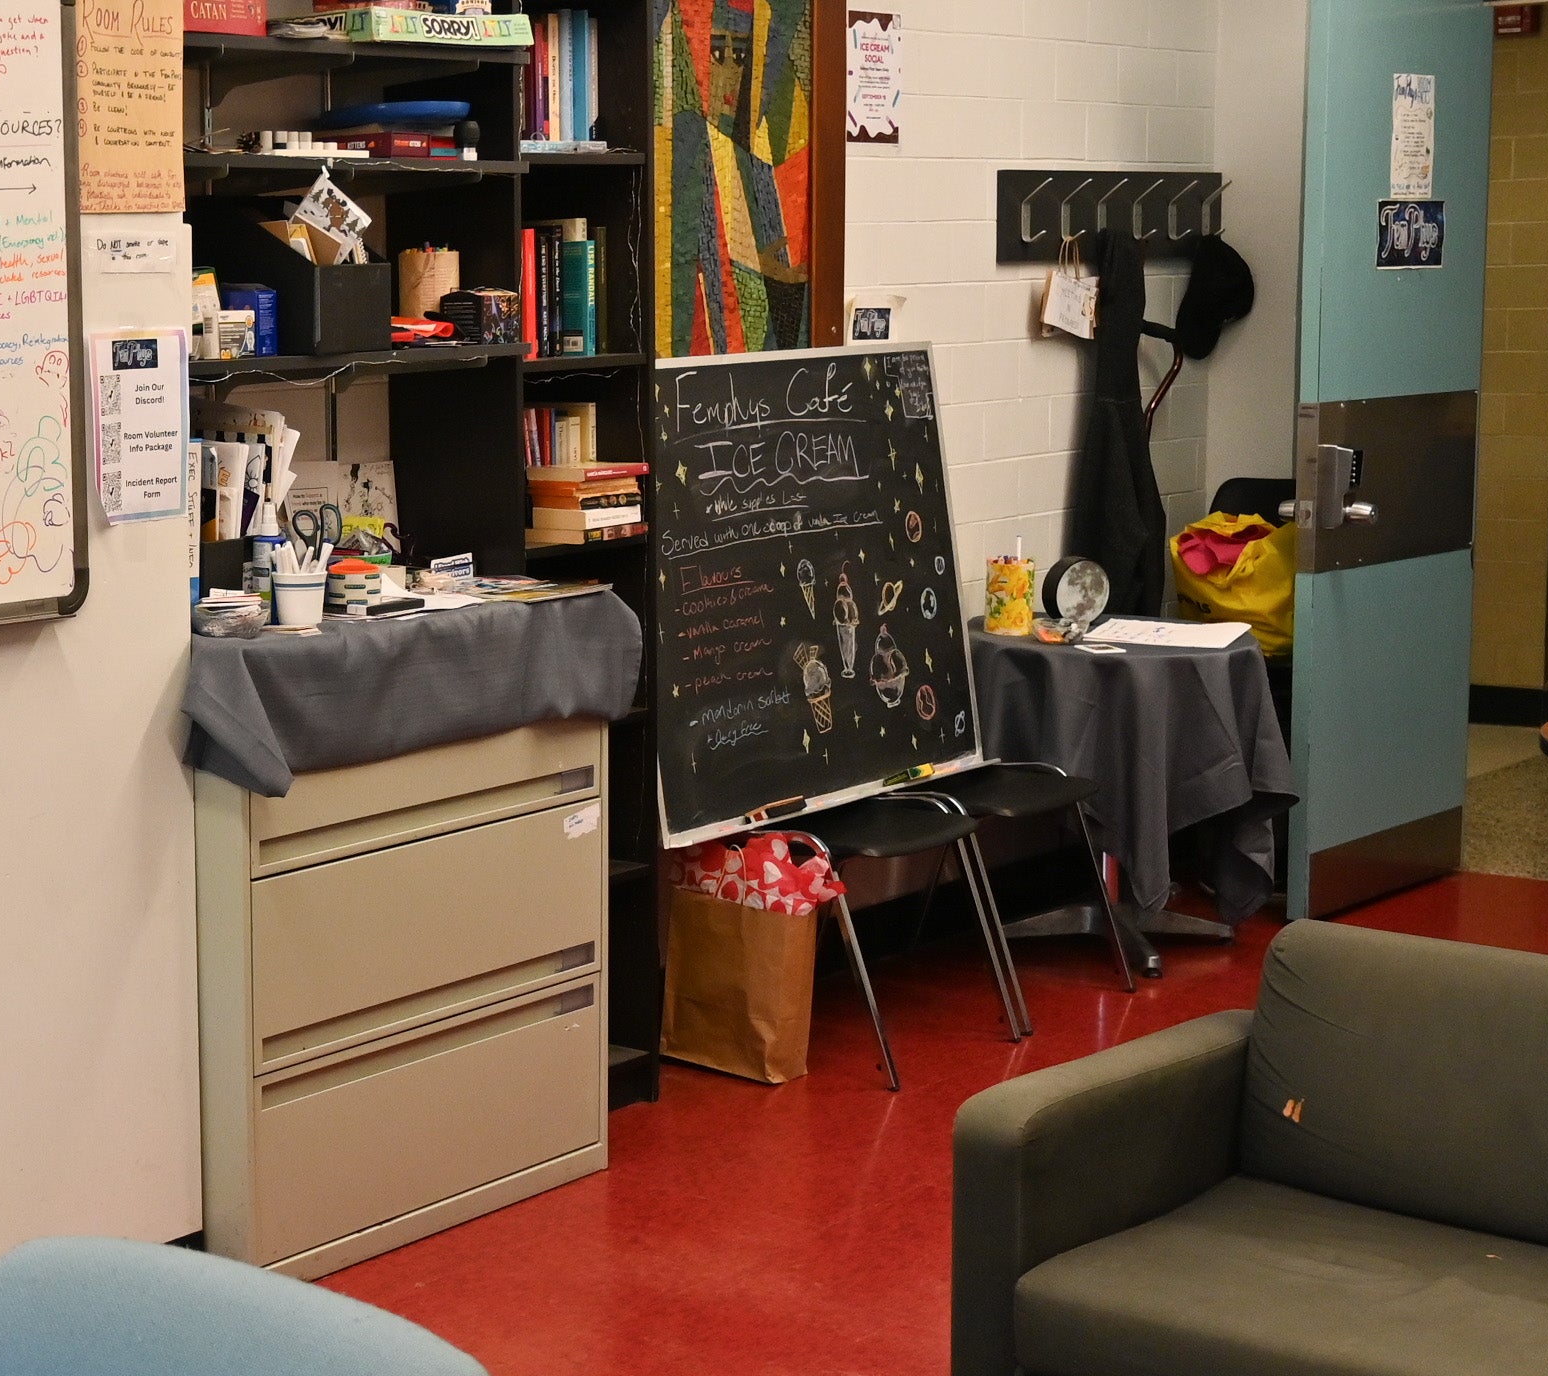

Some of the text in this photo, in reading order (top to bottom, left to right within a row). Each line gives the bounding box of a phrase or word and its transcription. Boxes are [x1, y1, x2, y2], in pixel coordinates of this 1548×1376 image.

[189, 0, 228, 21] CATAN
[8, 15, 22, 30] get
[421, 14, 479, 41] SORRY!
[21, 31, 36, 40] and
[870, 43, 890, 53] CREAM
[587, 245, 595, 307] LISA RANDALL
[134, 382, 165, 393] Join Our
[786, 362, 853, 416] Café
[135, 394, 165, 405] Discord!
[123, 429, 178, 441] Room Volunteer
[129, 442, 173, 453] Info Package
[694, 431, 860, 479] ICE CREAM
[125, 475, 177, 487] Incident Report
[143, 489, 161, 498] Form
